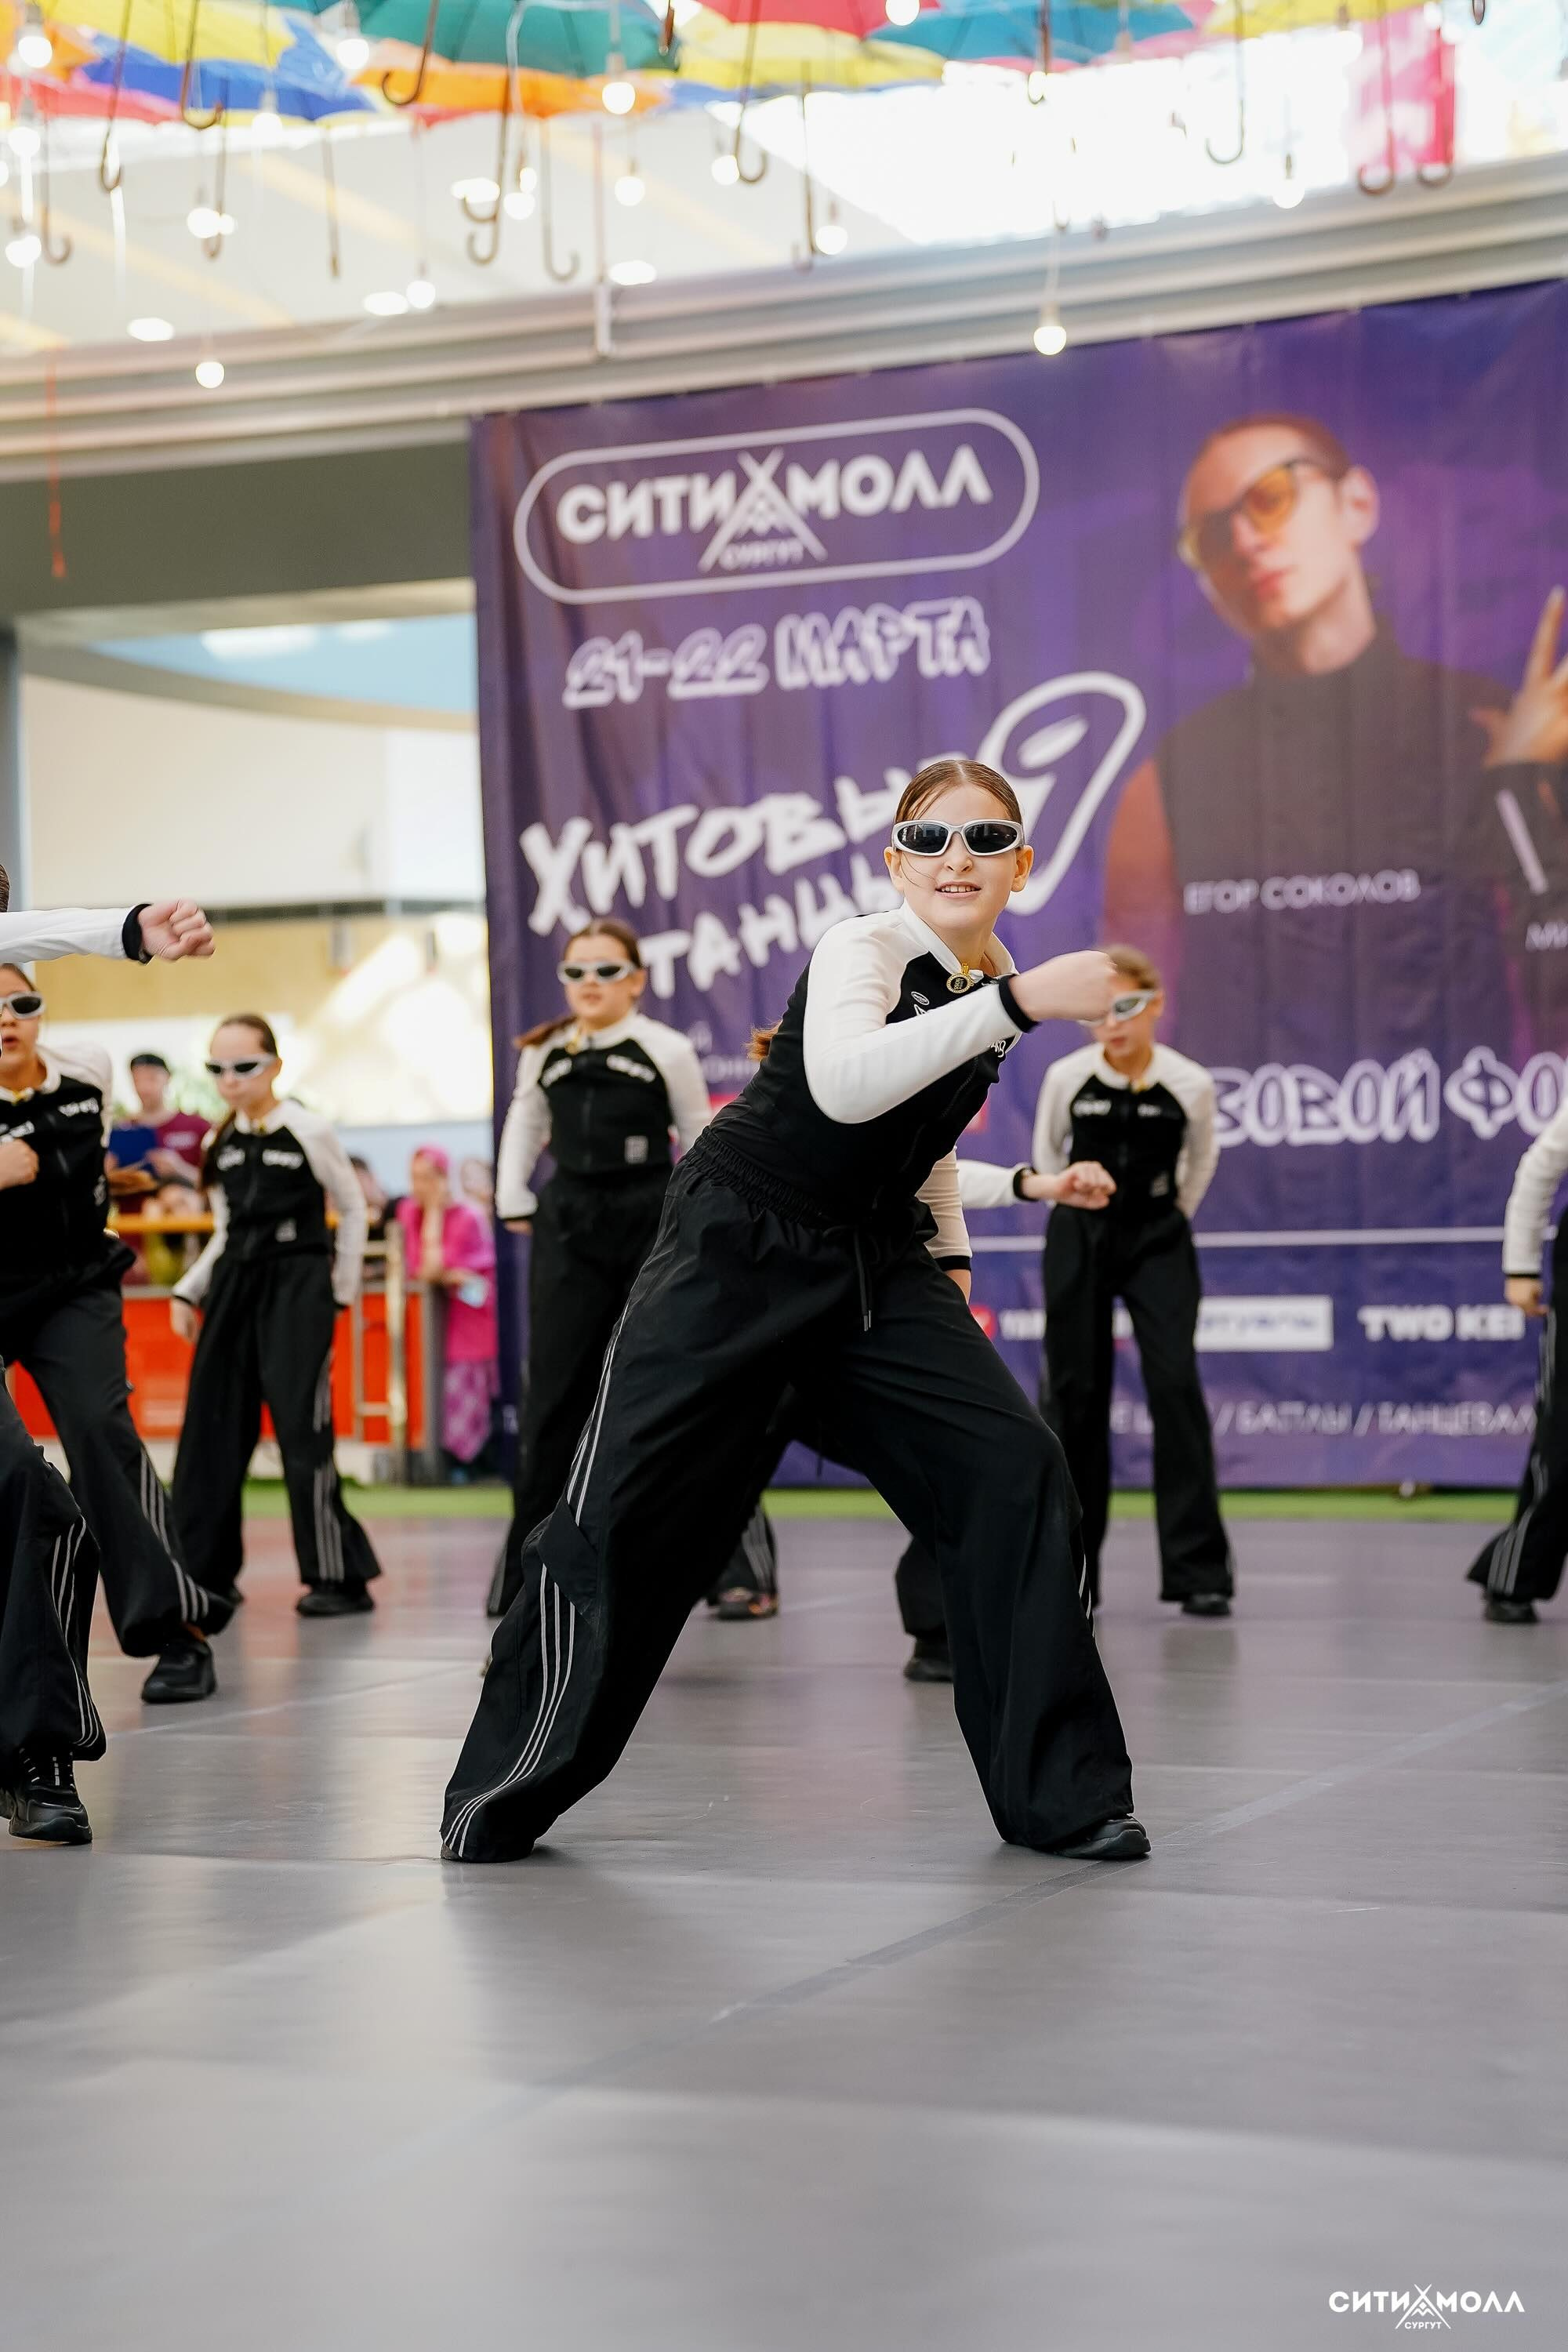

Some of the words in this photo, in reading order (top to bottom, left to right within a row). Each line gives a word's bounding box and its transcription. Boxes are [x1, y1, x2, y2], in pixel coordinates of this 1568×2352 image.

[556, 469, 737, 545] СИТИ
[786, 444, 994, 521] МОЛЛ
[561, 624, 769, 710] 21-22
[774, 595, 990, 691] МАРТА
[519, 750, 969, 937] ХИТОВЫ
[1183, 878, 1260, 916] ЕГОР
[1259, 867, 1421, 912] СОКОЛОВ
[1211, 1047, 1441, 1149] ЗОВОЙ
[1443, 1044, 1568, 1141] ФО
[1357, 1304, 1454, 1341] TWO
[1377, 1399, 1538, 1438] ТАНЦЕВАЛ
